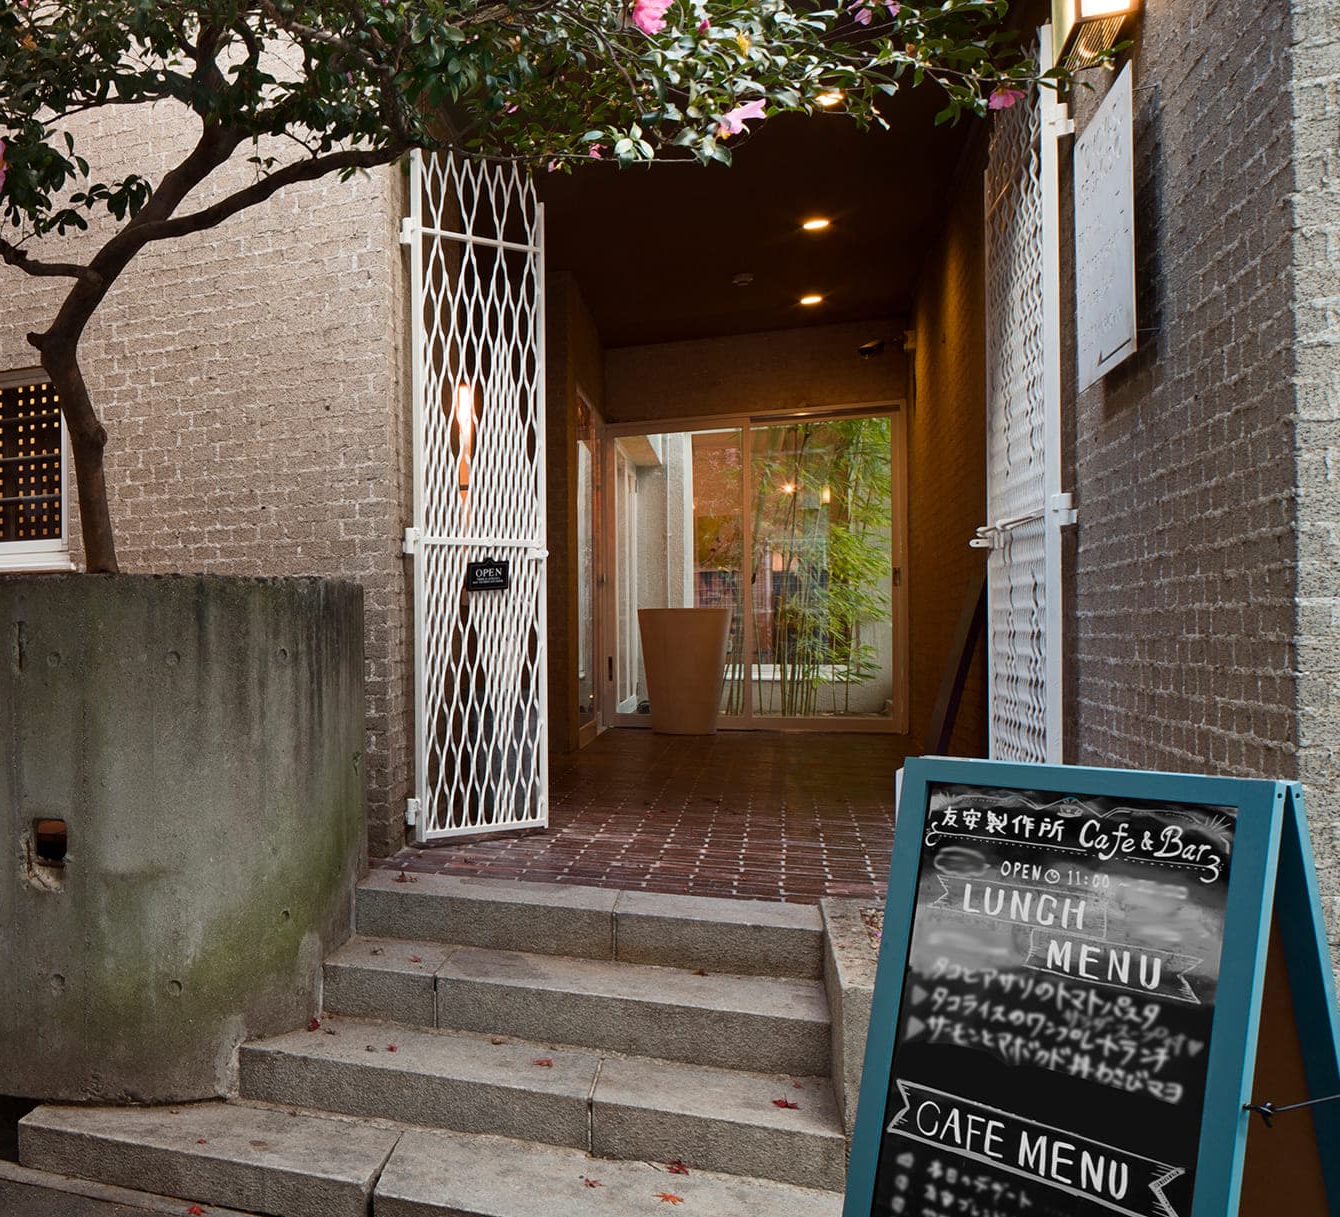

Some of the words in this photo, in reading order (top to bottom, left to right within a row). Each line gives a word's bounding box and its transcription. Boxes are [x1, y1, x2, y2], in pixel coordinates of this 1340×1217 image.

[475, 567, 503, 578] OPEN
[940, 805, 1066, 842] 友安製作所
[1078, 819, 1136, 861] Cafe
[1140, 830, 1154, 851] &
[1153, 824, 1212, 863] Bar
[1000, 860, 1042, 881] OPEN
[1066, 869, 1110, 888] 11:00
[962, 883, 1086, 930] LUNCH
[1046, 939, 1161, 990] MENU
[916, 1100, 1006, 1159] CAFE
[1018, 1130, 1128, 1201] MENU
